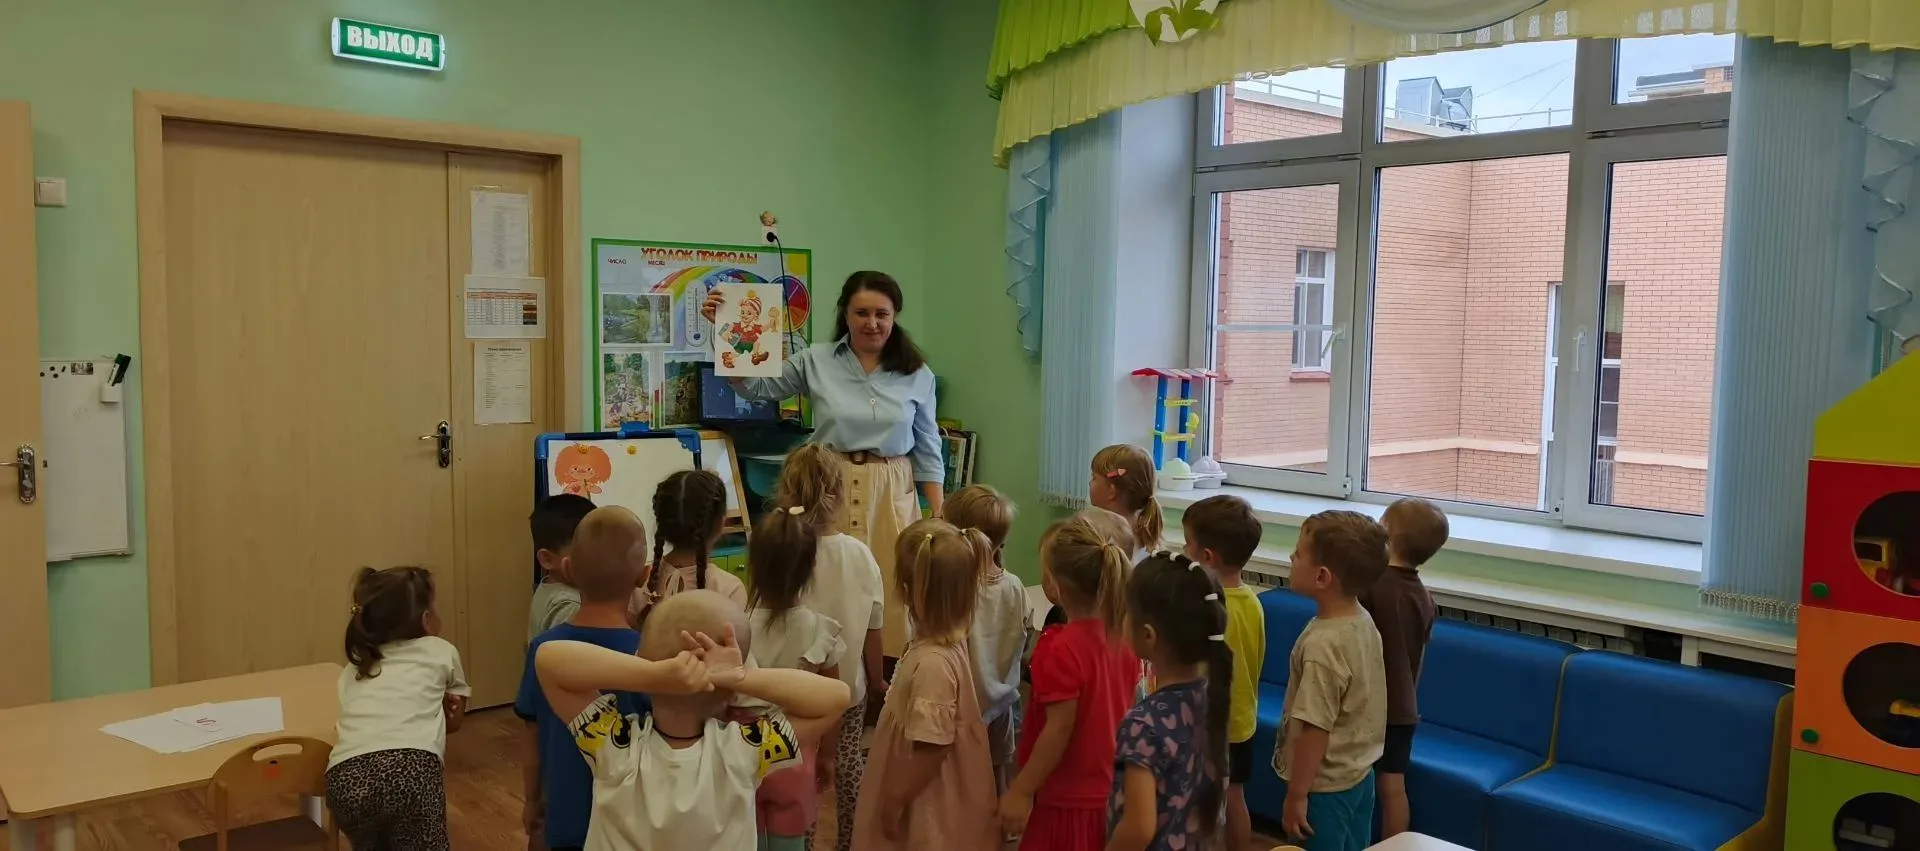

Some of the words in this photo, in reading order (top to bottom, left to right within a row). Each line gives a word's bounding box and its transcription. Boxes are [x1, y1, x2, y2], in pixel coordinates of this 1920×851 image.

[347, 25, 433, 61] ВЫХОД
[641, 248, 694, 261] УГОЛОК
[696, 250, 758, 264] ПРИРОДЫ
